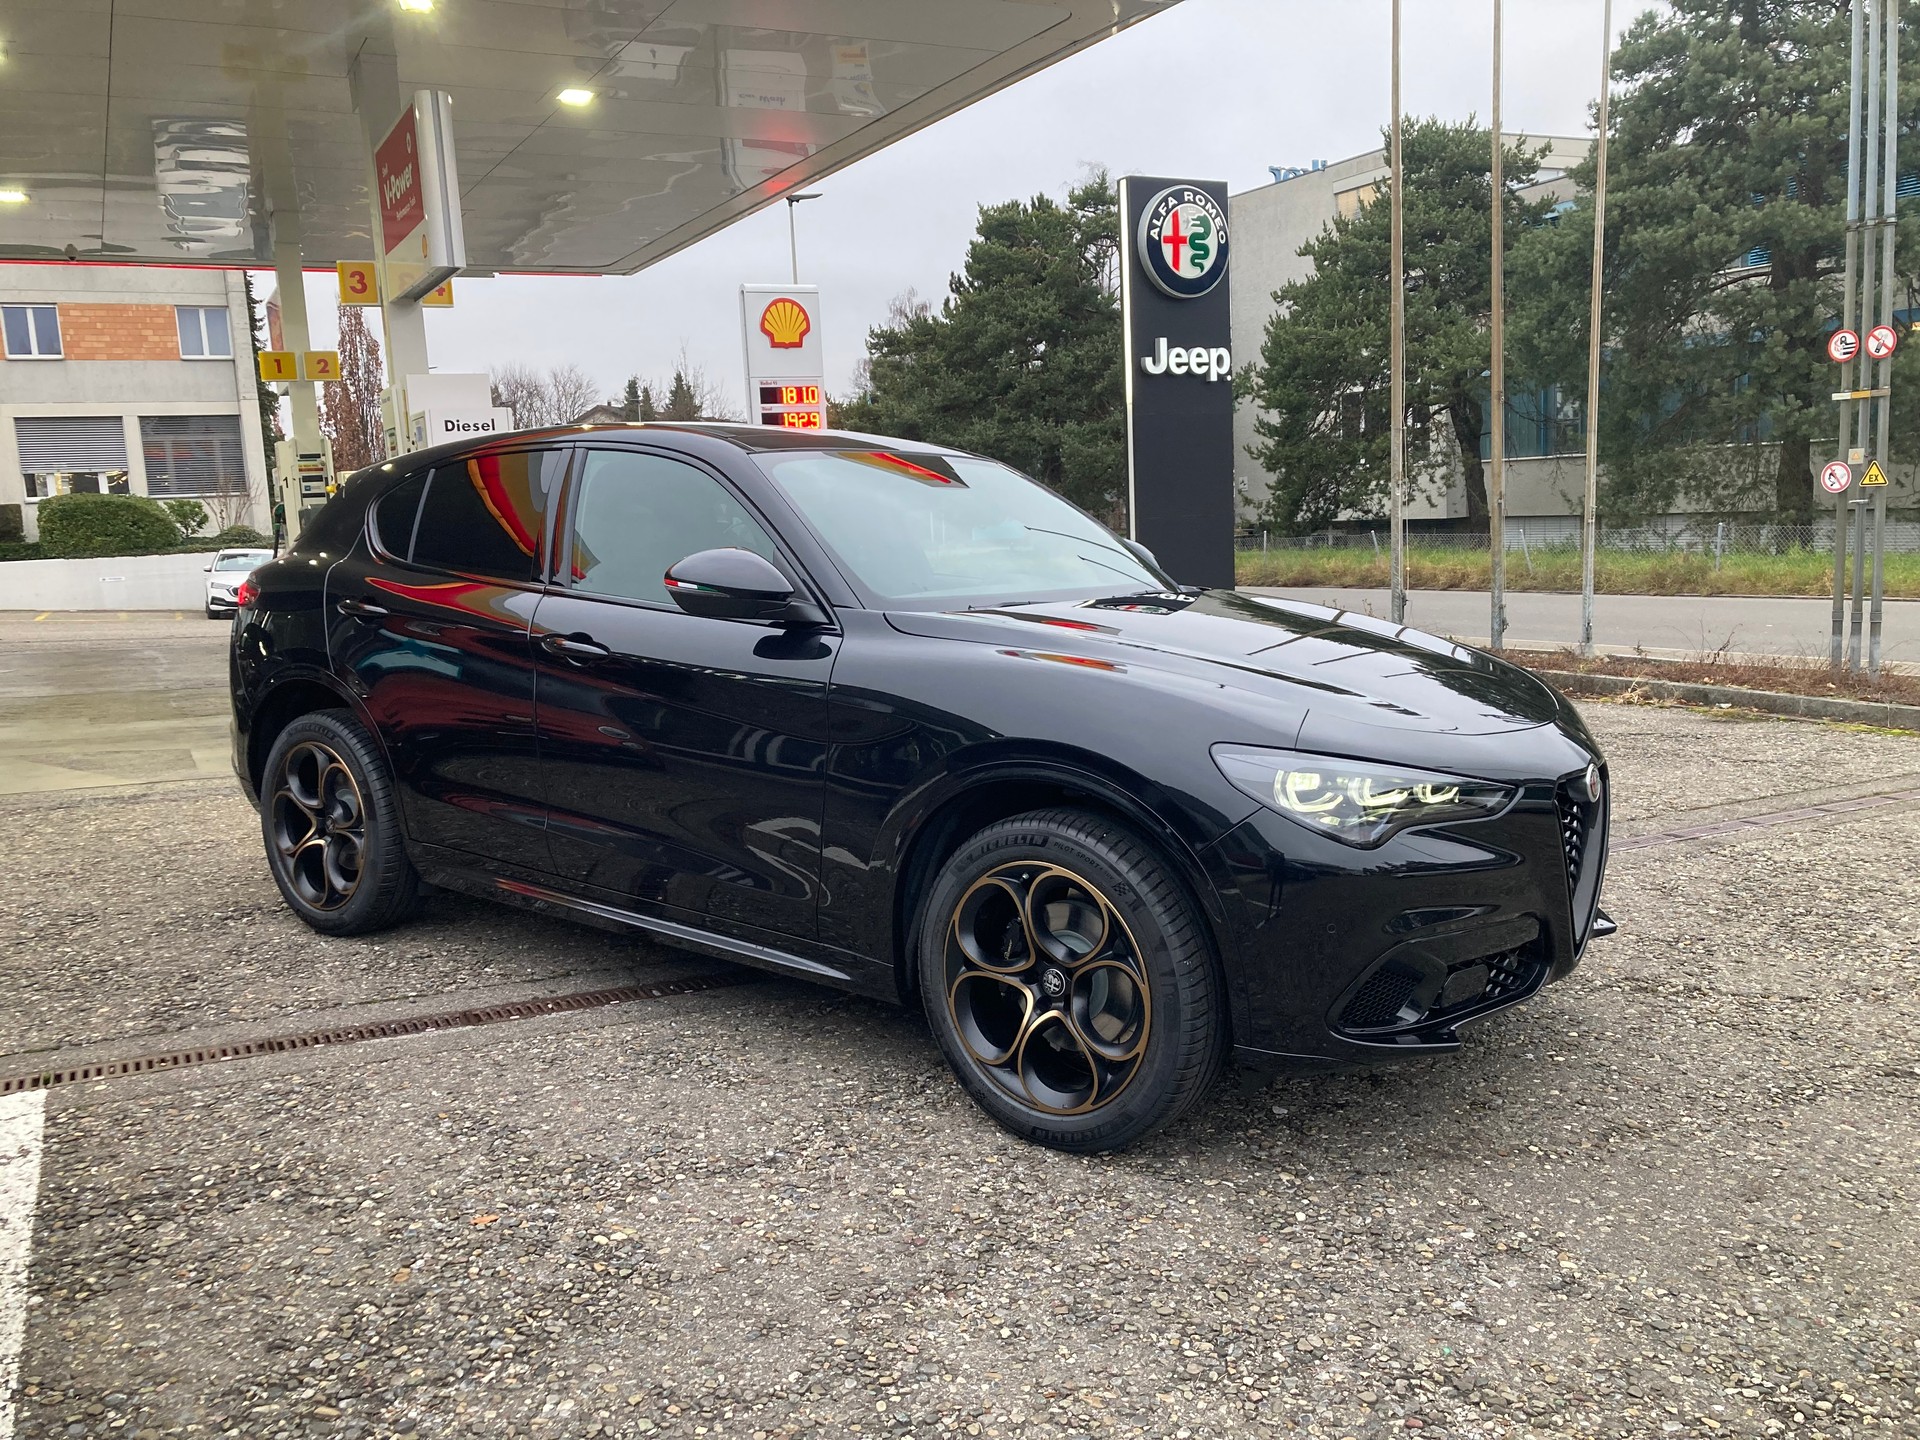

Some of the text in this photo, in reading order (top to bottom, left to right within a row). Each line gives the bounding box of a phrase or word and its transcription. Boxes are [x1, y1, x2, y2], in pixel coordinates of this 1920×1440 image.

[383, 162, 413, 210] V-Power
[1149, 191, 1227, 245] ALFA ROMEO
[349, 270, 368, 294] 3
[274, 359, 283, 374] 1
[317, 359, 330, 374] 2
[444, 418, 496, 432] Diesel
[282, 476, 289, 489] 1
[1053, 840, 1075, 854] PILOT
[1075, 851, 1100, 870] SPORT
